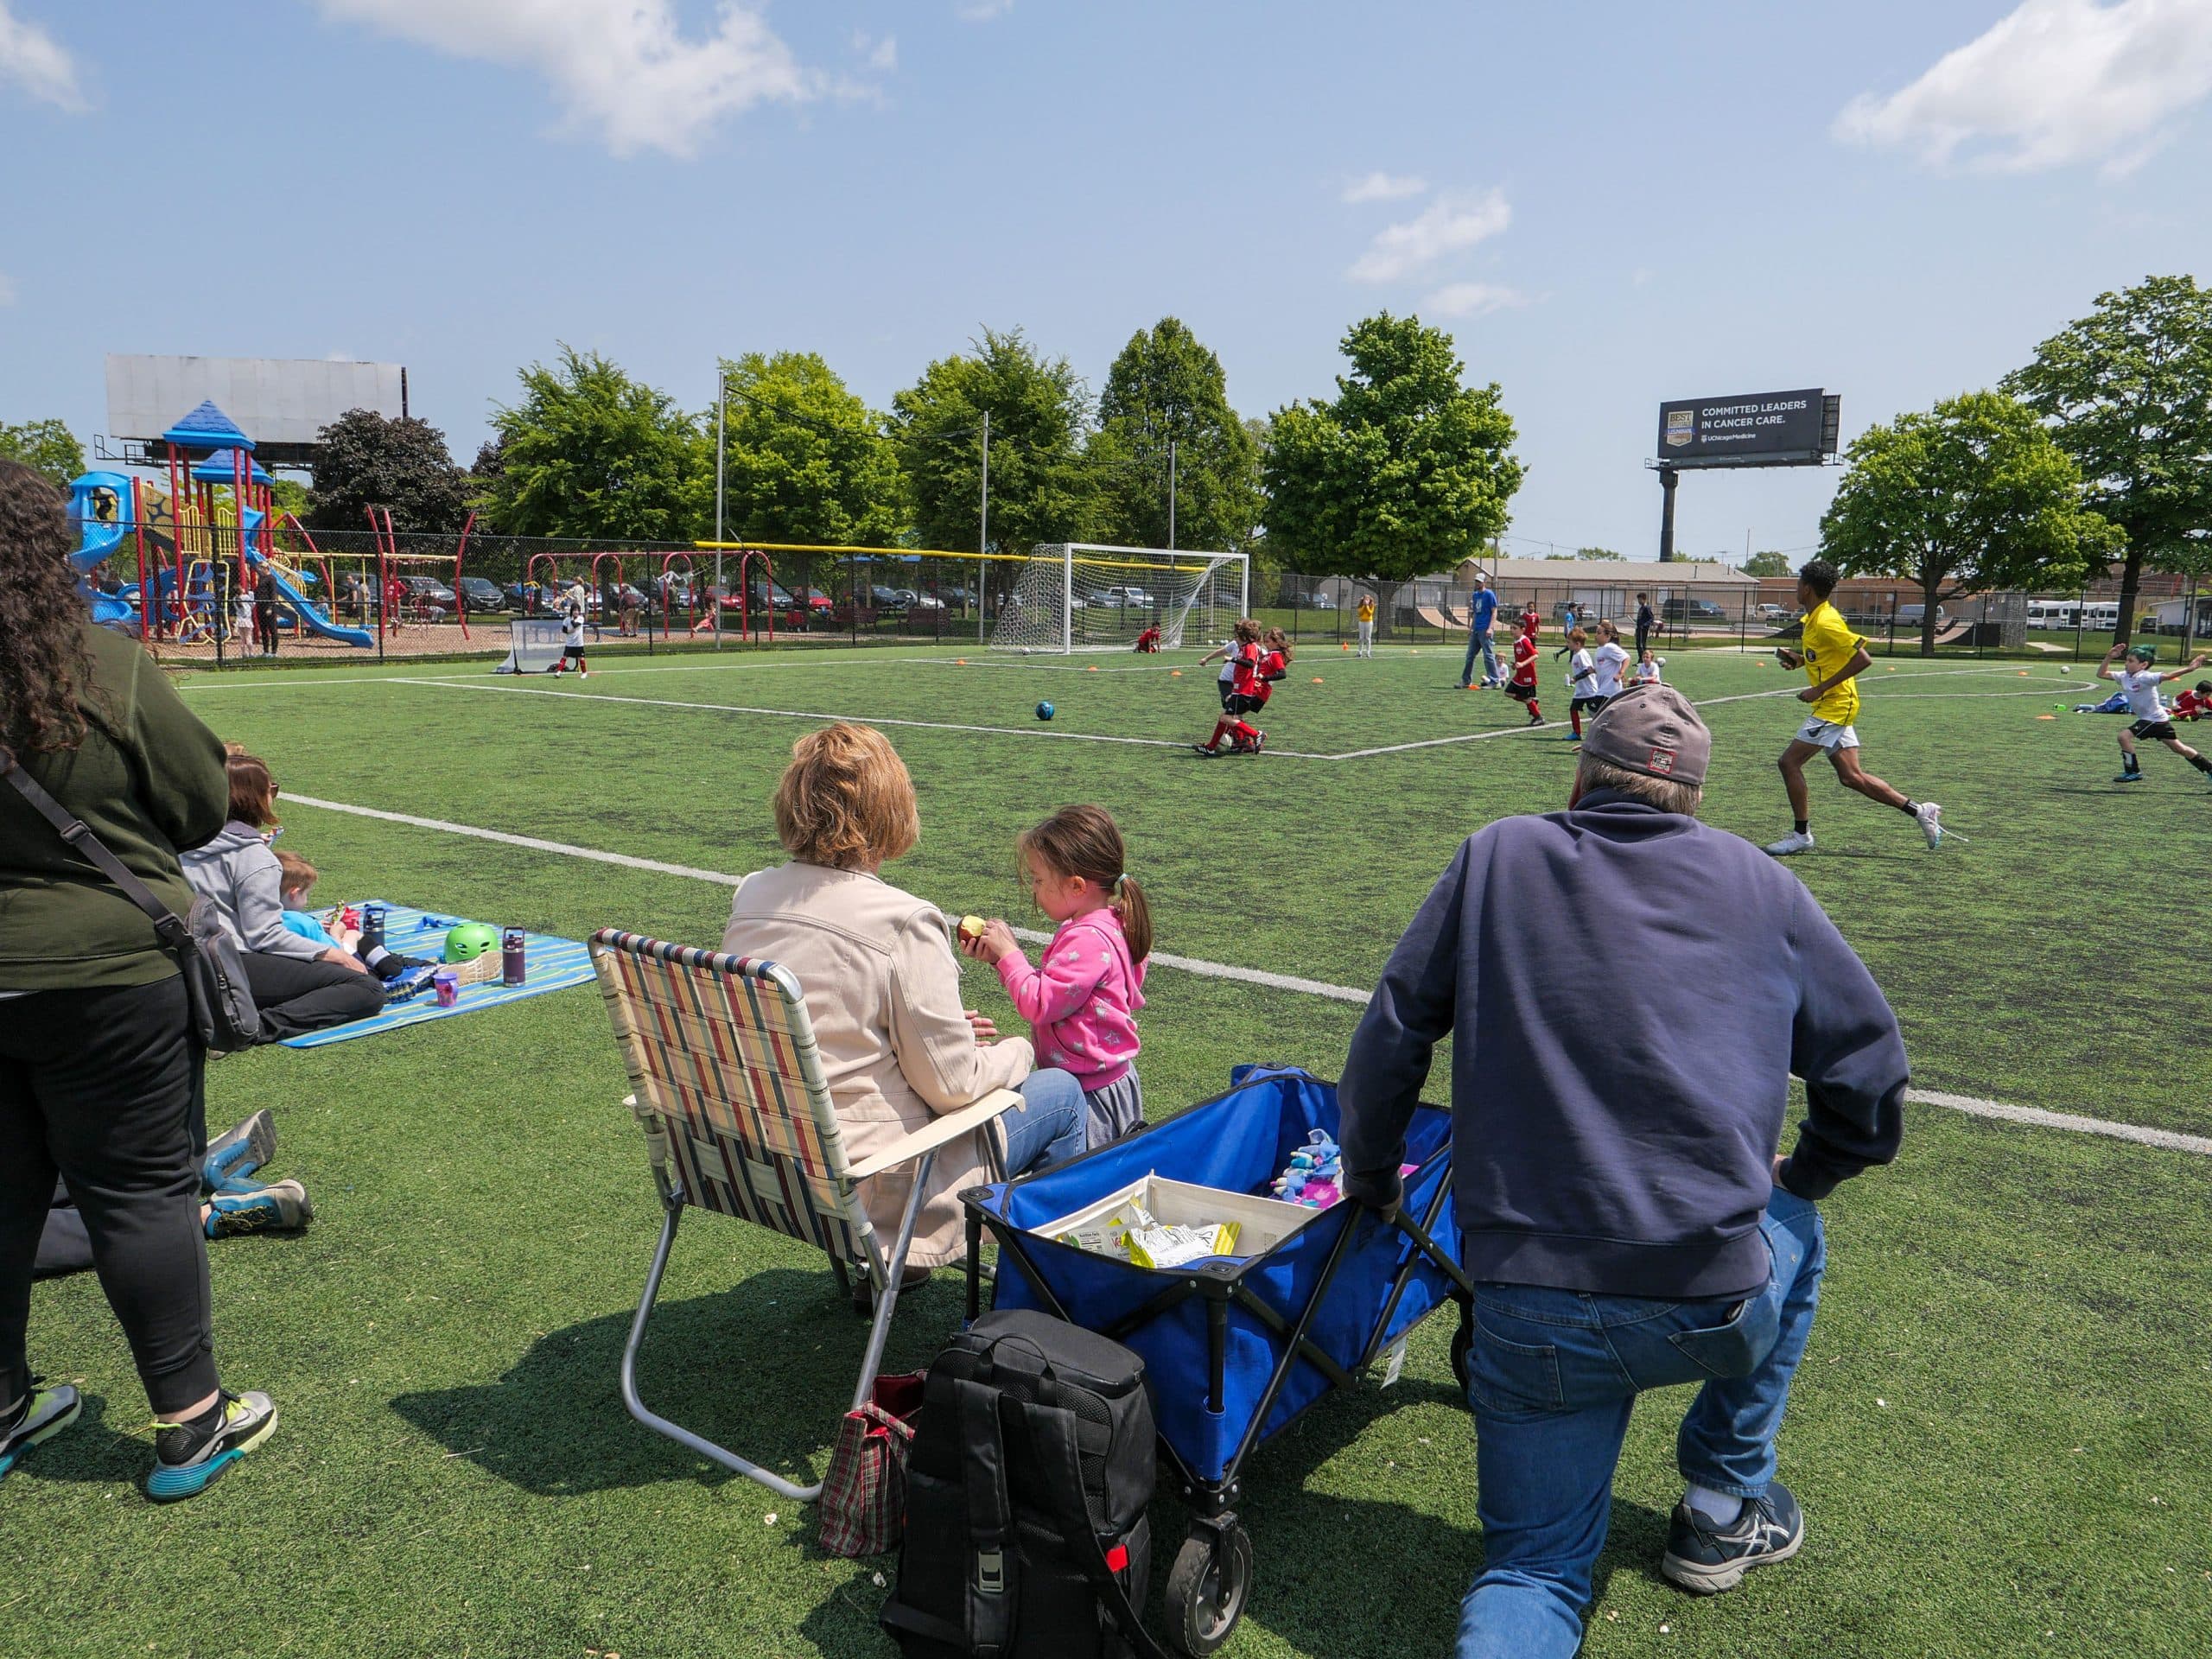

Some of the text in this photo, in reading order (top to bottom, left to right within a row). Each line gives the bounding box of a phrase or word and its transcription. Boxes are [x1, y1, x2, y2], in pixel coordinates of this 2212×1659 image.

[1702, 400, 1807, 416] COMMITTED LEADERS
[1670, 413, 1692, 422] BEST
[1701, 421, 1711, 429] IN
[1713, 417, 1753, 429] CANCER
[1755, 415, 1785, 425] CARE.
